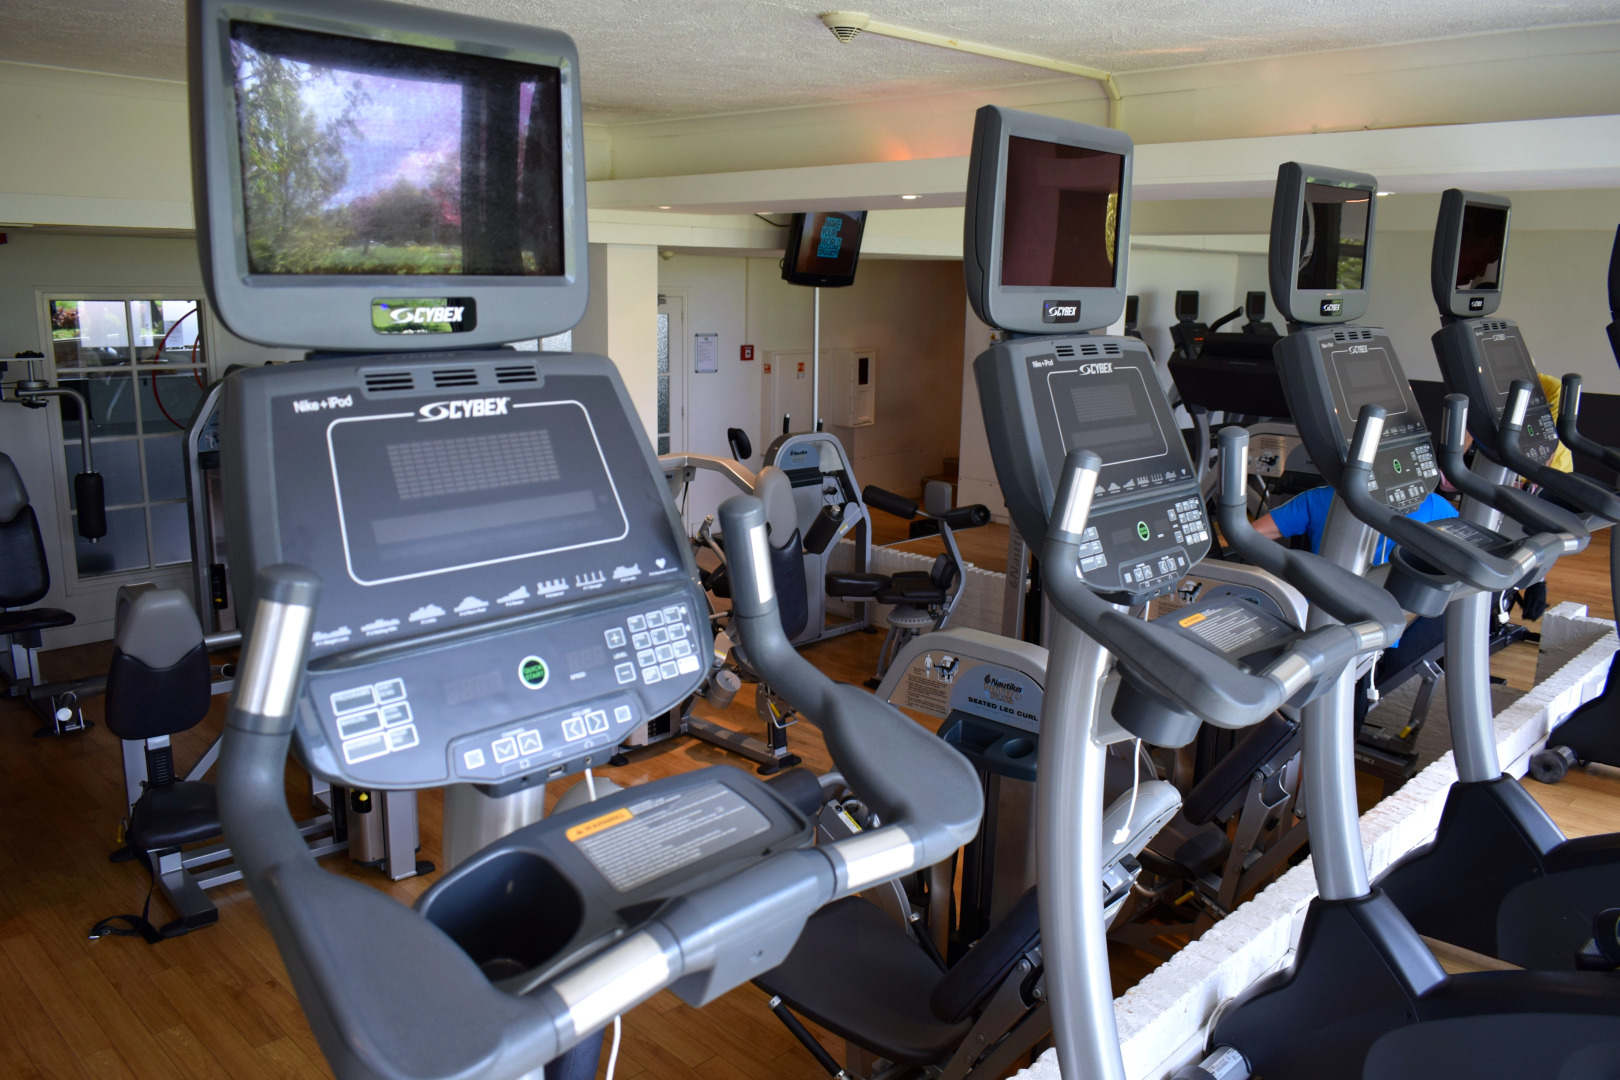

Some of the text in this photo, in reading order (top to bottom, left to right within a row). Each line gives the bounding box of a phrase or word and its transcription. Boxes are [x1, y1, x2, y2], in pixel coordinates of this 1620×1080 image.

[826, 218, 842, 229] MAKE
[822, 227, 837, 237] YOUR
[821, 237, 841, 247] WORLD
[818, 246, 840, 256] BIGGER
[413, 307, 464, 323] CYBEX
[1057, 306, 1077, 317] CYBEX
[1090, 362, 1113, 375] CYBEX
[449, 398, 508, 420] CYBEX
[523, 664, 544, 674] QUICK
[524, 670, 545, 681] START
[990, 678, 1022, 693] Nautilus
[984, 683, 1023, 701] NITRO
[990, 692, 1014, 705] PLUS
[968, 696, 997, 710] SEATED
[999, 705, 1015, 715] LEG
[1016, 710, 1039, 722] CURL
